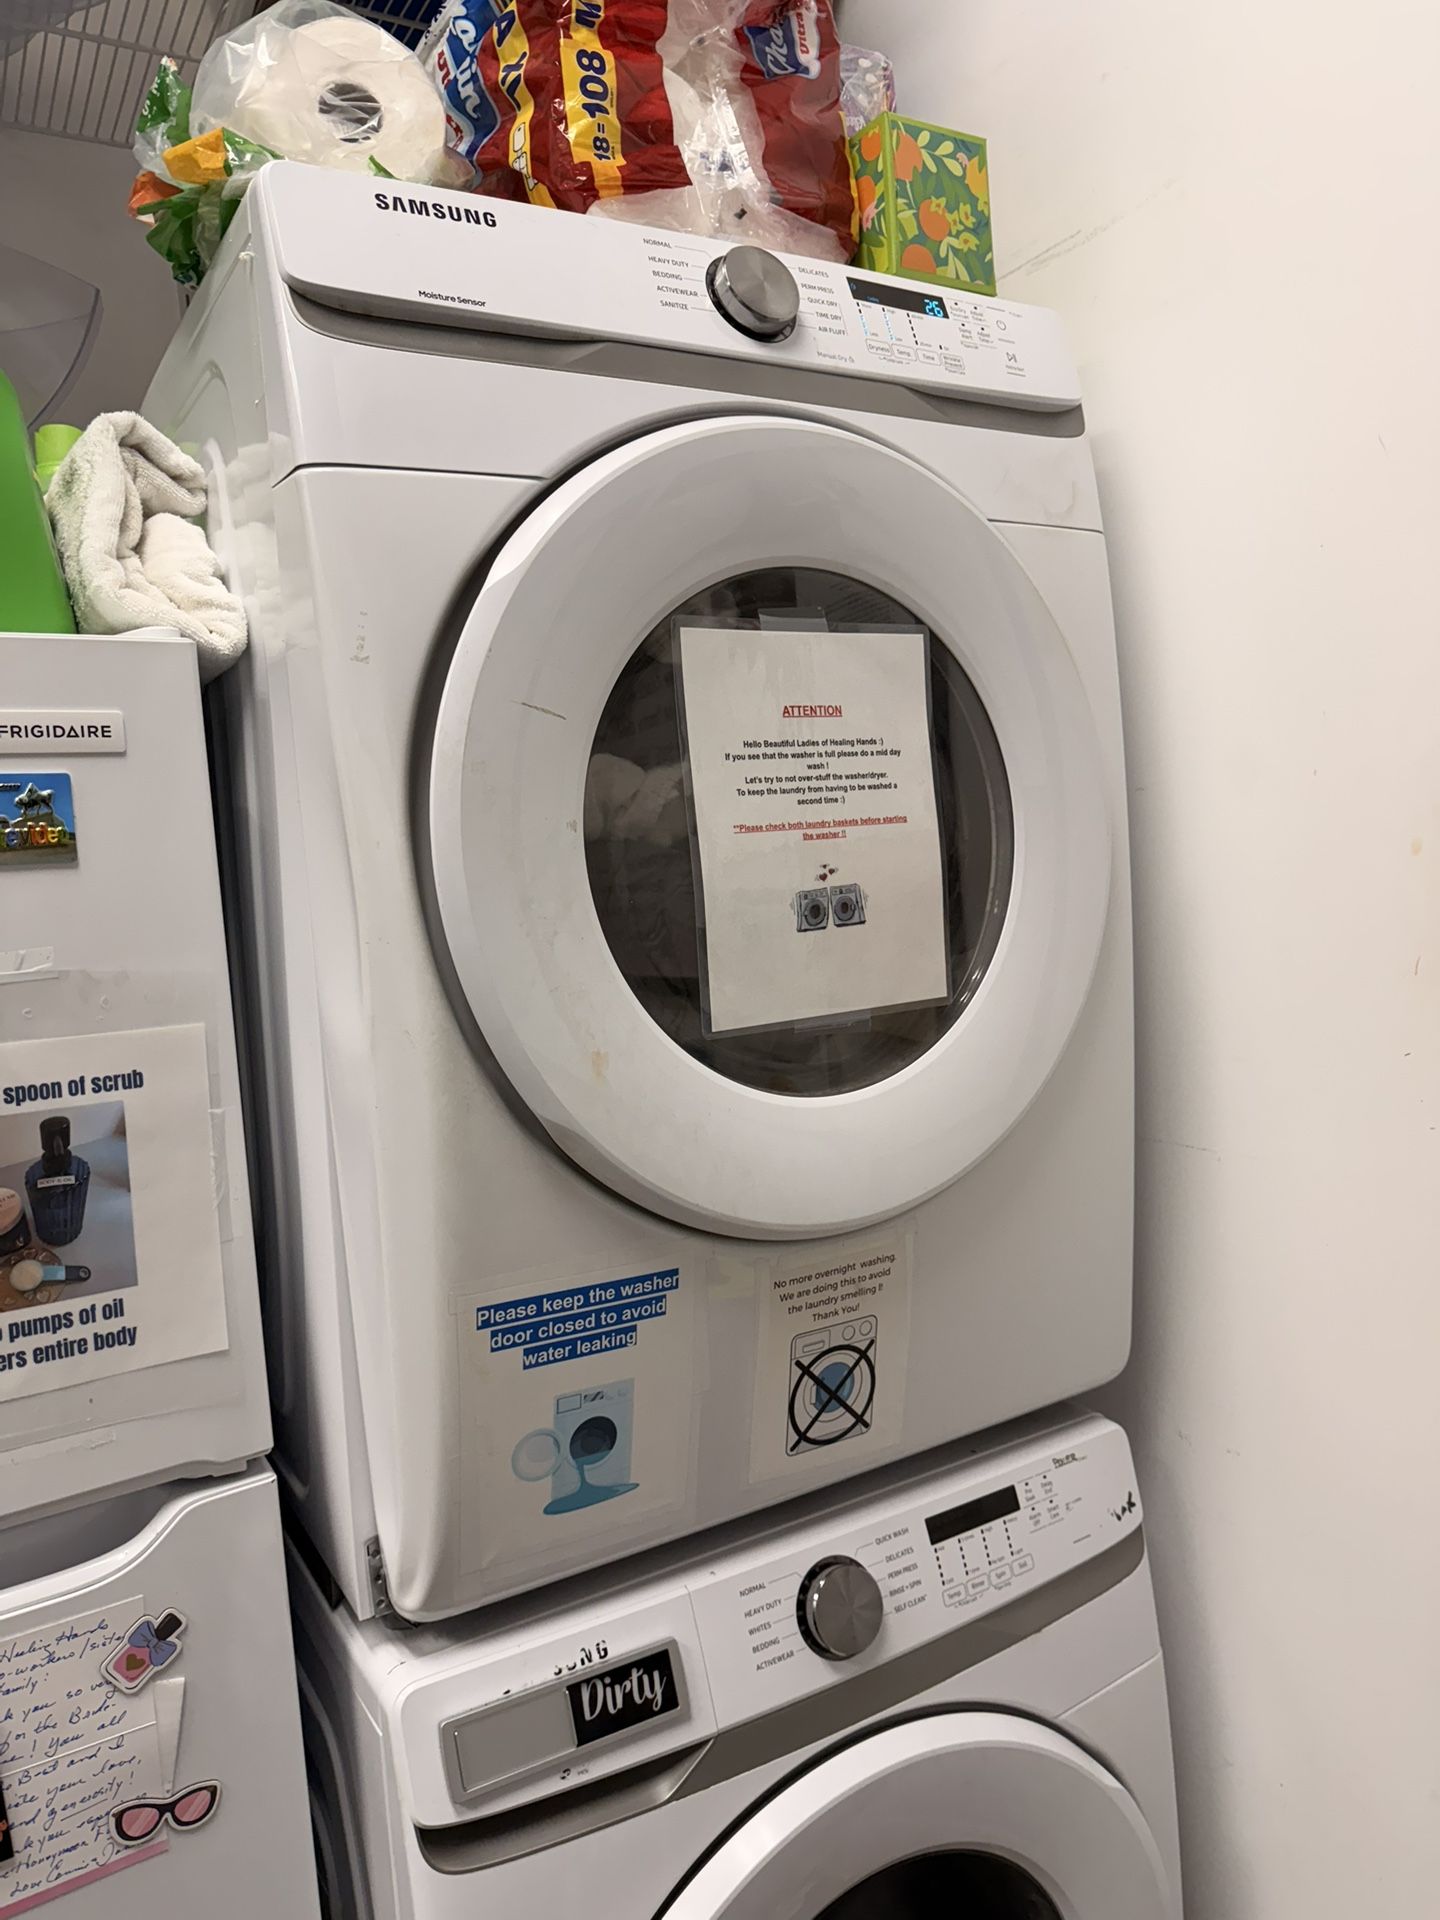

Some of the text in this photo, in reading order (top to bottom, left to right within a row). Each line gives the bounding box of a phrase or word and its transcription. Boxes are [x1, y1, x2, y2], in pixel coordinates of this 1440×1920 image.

[374, 193, 497, 228] SAMSUNG
[643, 238, 673, 248] NORMAL
[648, 256, 690, 268] HEAVY DUTY
[652, 270, 682, 281] BEDDING
[798, 267, 830, 278] DELICATES
[657, 285, 698, 298] ACTIVEWEAR
[801, 283, 835, 294] PERM PRESS
[418, 290, 486, 307] Moisture Sensor
[660, 300, 690, 311] SANITIZE
[807, 297, 838, 308] QUICK DRY
[924, 299, 944, 318] 26
[815, 312, 842, 322] TIME DRY
[818, 326, 846, 336] AIR FLUFF
[782, 704, 843, 718] ATTENTION
[0, 724, 112, 738] FRIGIDAIRE
[743, 737, 884, 748] Hello Beautiful Ladies of Healing Hands :)
[724, 753, 730, 761] If
[732, 754, 746, 762] you
[762, 752, 776, 760] that
[777, 752, 789, 760] the
[790, 751, 815, 759] washer
[817, 750, 823, 758] is
[824, 750, 836, 758] full
[837, 750, 858, 759] please
[860, 749, 869, 757] do
[889, 748, 901, 757] day
[807, 762, 825, 770] wash
[745, 776, 762, 784] Let's
[764, 776, 774, 785] try
[798, 773, 831, 782] over-stuff
[736, 788, 746, 796] To
[748, 788, 765, 797] keep
[766, 787, 778, 795] the
[779, 786, 806, 796] laundry
[808, 785, 824, 793] from
[825, 784, 848, 794] having
[867, 782, 892, 790] washed
[797, 796, 822, 805] second
[840, 795, 845, 804] :)
[765, 822, 786, 832] check
[788, 821, 804, 831] both
[805, 820, 831, 830] laundry
[832, 818, 858, 828] baskets
[860, 816, 881, 826] before
[882, 815, 908, 824] starting
[803, 831, 814, 841] the
[816, 830, 840, 840] washer
[3, 1069, 144, 1106] spoon of scrub
[773, 1254, 896, 1290] No more overnight washing
[779, 1267, 892, 1302] We are doing this to avoid
[477, 1274, 680, 1327] Please keep the washer
[788, 1285, 877, 1314] the laundry smelling
[8, 1311, 74, 1343] pumps
[79, 1304, 98, 1326] of
[102, 1298, 125, 1320] oil
[812, 1303, 860, 1322] Thank You!
[490, 1298, 666, 1349] door closed to avoid
[32, 1336, 88, 1364] entire
[94, 1326, 138, 1352] body
[523, 1330, 638, 1366] water leaking
[874, 1528, 910, 1546] QUICK WASH
[885, 1546, 914, 1563] DELICATES
[888, 1562, 918, 1580] PERM PRESS
[739, 1582, 766, 1598] NORMAL
[888, 1580, 922, 1598] RINSE SPIN
[744, 1599, 782, 1619] HEAVY DUTY
[894, 1602, 907, 1614] SELF
[748, 1622, 772, 1636] WHITES
[752, 1638, 780, 1654] BEDDING
[756, 1650, 795, 1672] ACTIVEWEAR
[66, 1688, 83, 1700] so
[580, 1667, 667, 1723] Dirty
[34, 1714, 58, 1734] the
[97, 1710, 128, 1731] all
[67, 1746, 102, 1768] and
